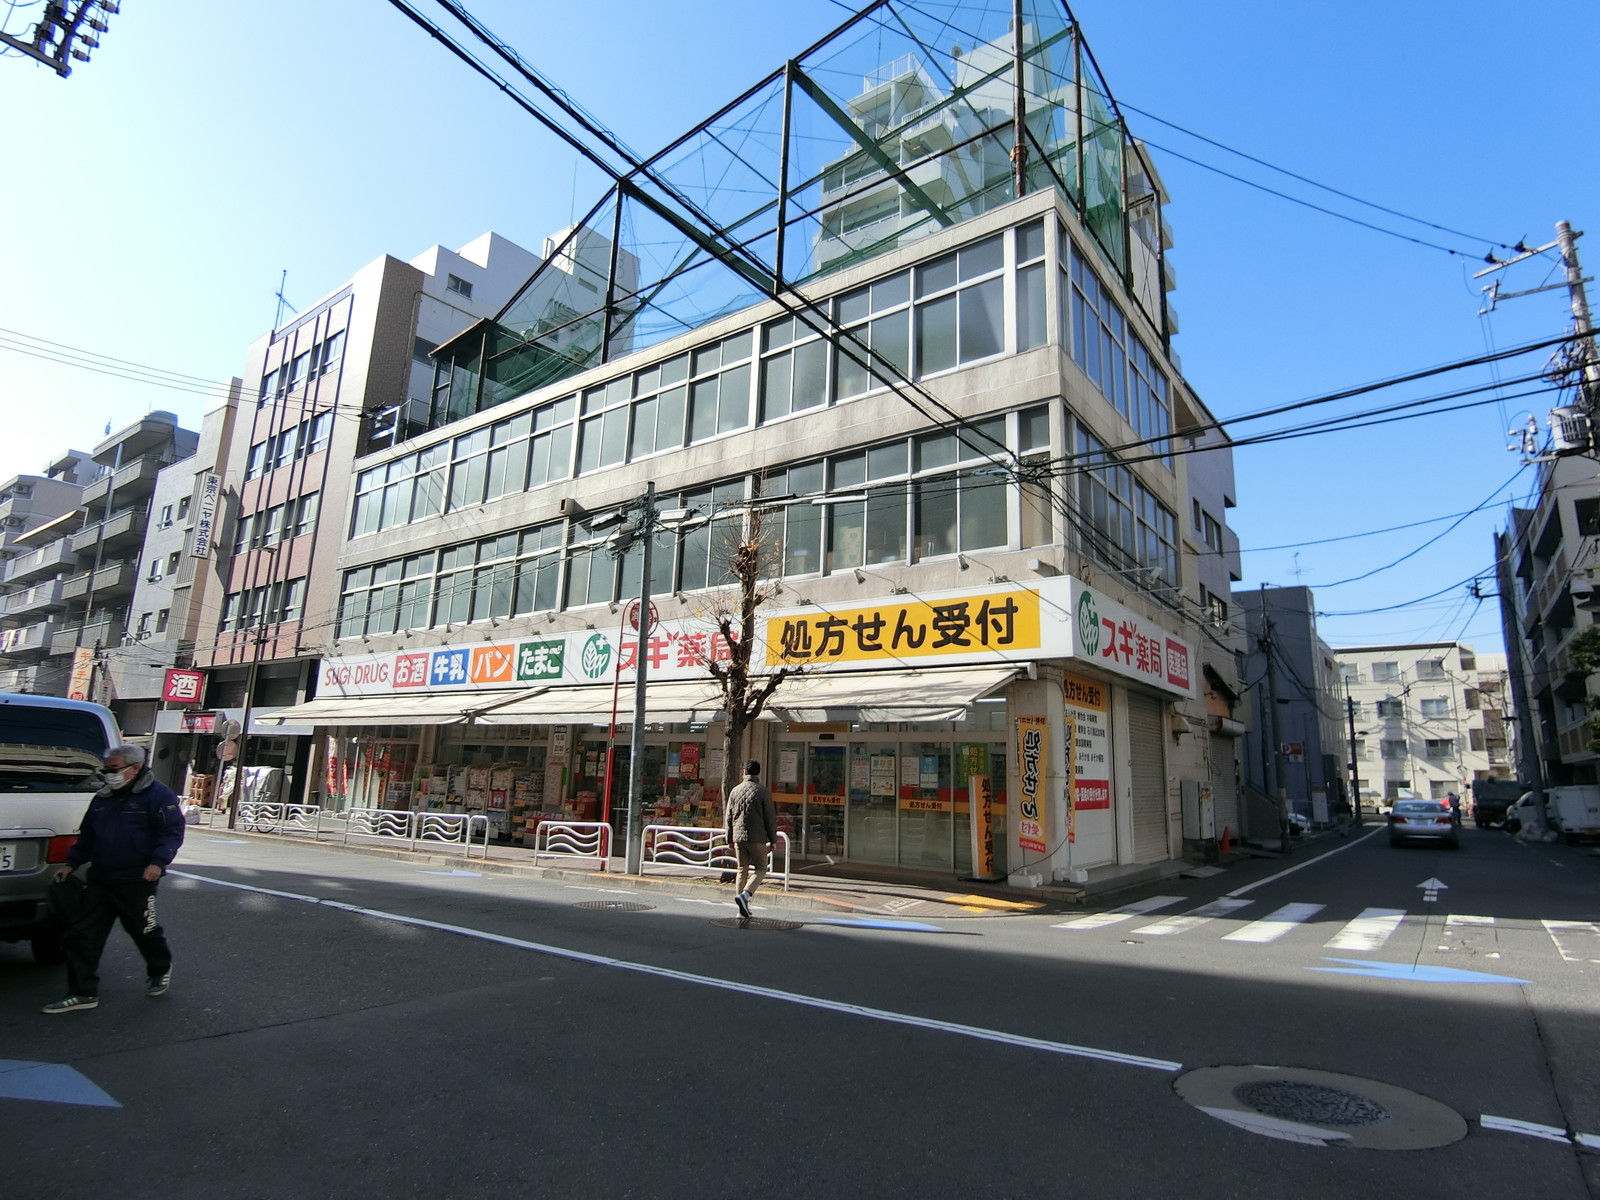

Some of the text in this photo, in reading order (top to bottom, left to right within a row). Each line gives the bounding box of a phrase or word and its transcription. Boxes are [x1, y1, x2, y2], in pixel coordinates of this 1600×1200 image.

[195, 475, 218, 556] 東京ベニヤ株式会社
[780, 597, 1019, 660] 処方せん受付
[519, 643, 563, 677] たまご
[1101, 616, 1163, 678] スギ薬局
[324, 661, 390, 686] SUGI DRUG
[394, 656, 427, 686] お酒
[433, 652, 467, 683] 牛乳
[472, 648, 512, 679] パン
[1167, 647, 1188, 681] 医薬品
[168, 673, 200, 699] 酒
[812, 795, 841, 804] 処方せん受付
[909, 801, 942, 810] 処方せん受付
